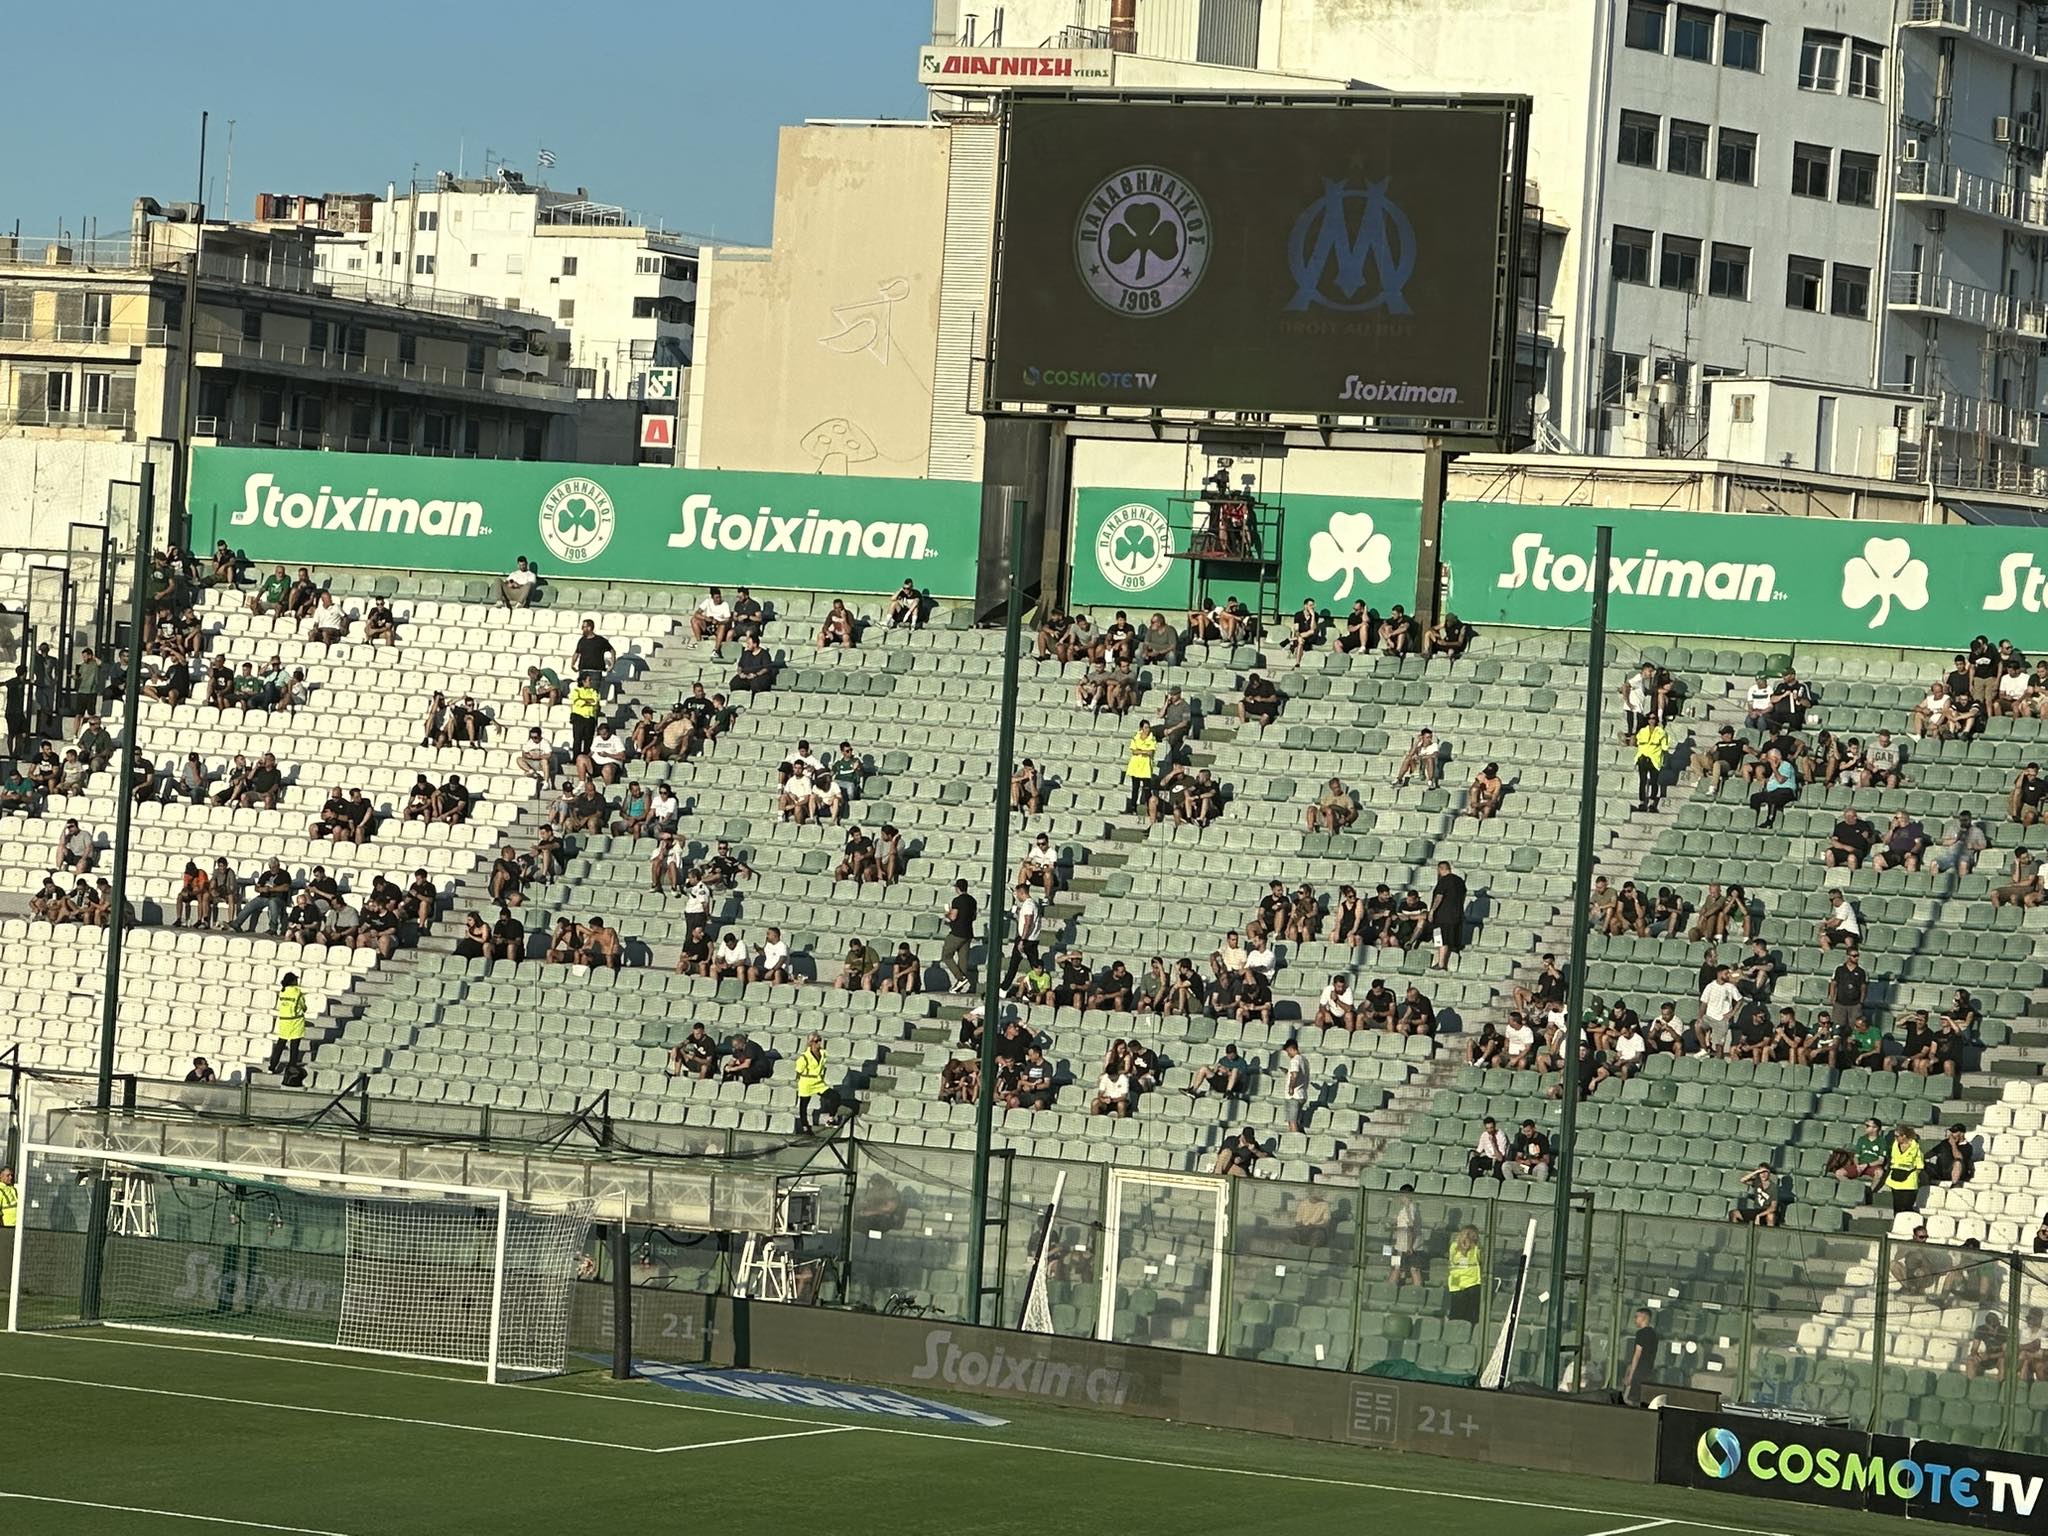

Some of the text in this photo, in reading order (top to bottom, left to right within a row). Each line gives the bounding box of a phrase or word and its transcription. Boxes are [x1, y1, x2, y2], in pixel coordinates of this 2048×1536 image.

[1119, 289, 1162, 311] 1908
[1338, 374, 1457, 403] Stoiximan
[230, 473, 484, 537] Stoiximan
[667, 494, 929, 560] Stoiximan
[564, 547, 587, 560] 1908
[1121, 575, 1145, 588] 1908
[1773, 591, 1788, 600] 21+
[1982, 552, 2048, 613] St
[661, 1313, 720, 1341] 21+
[1417, 1405, 1480, 1438] 21+
[1747, 1439, 2044, 1516] COSMOTE TV
